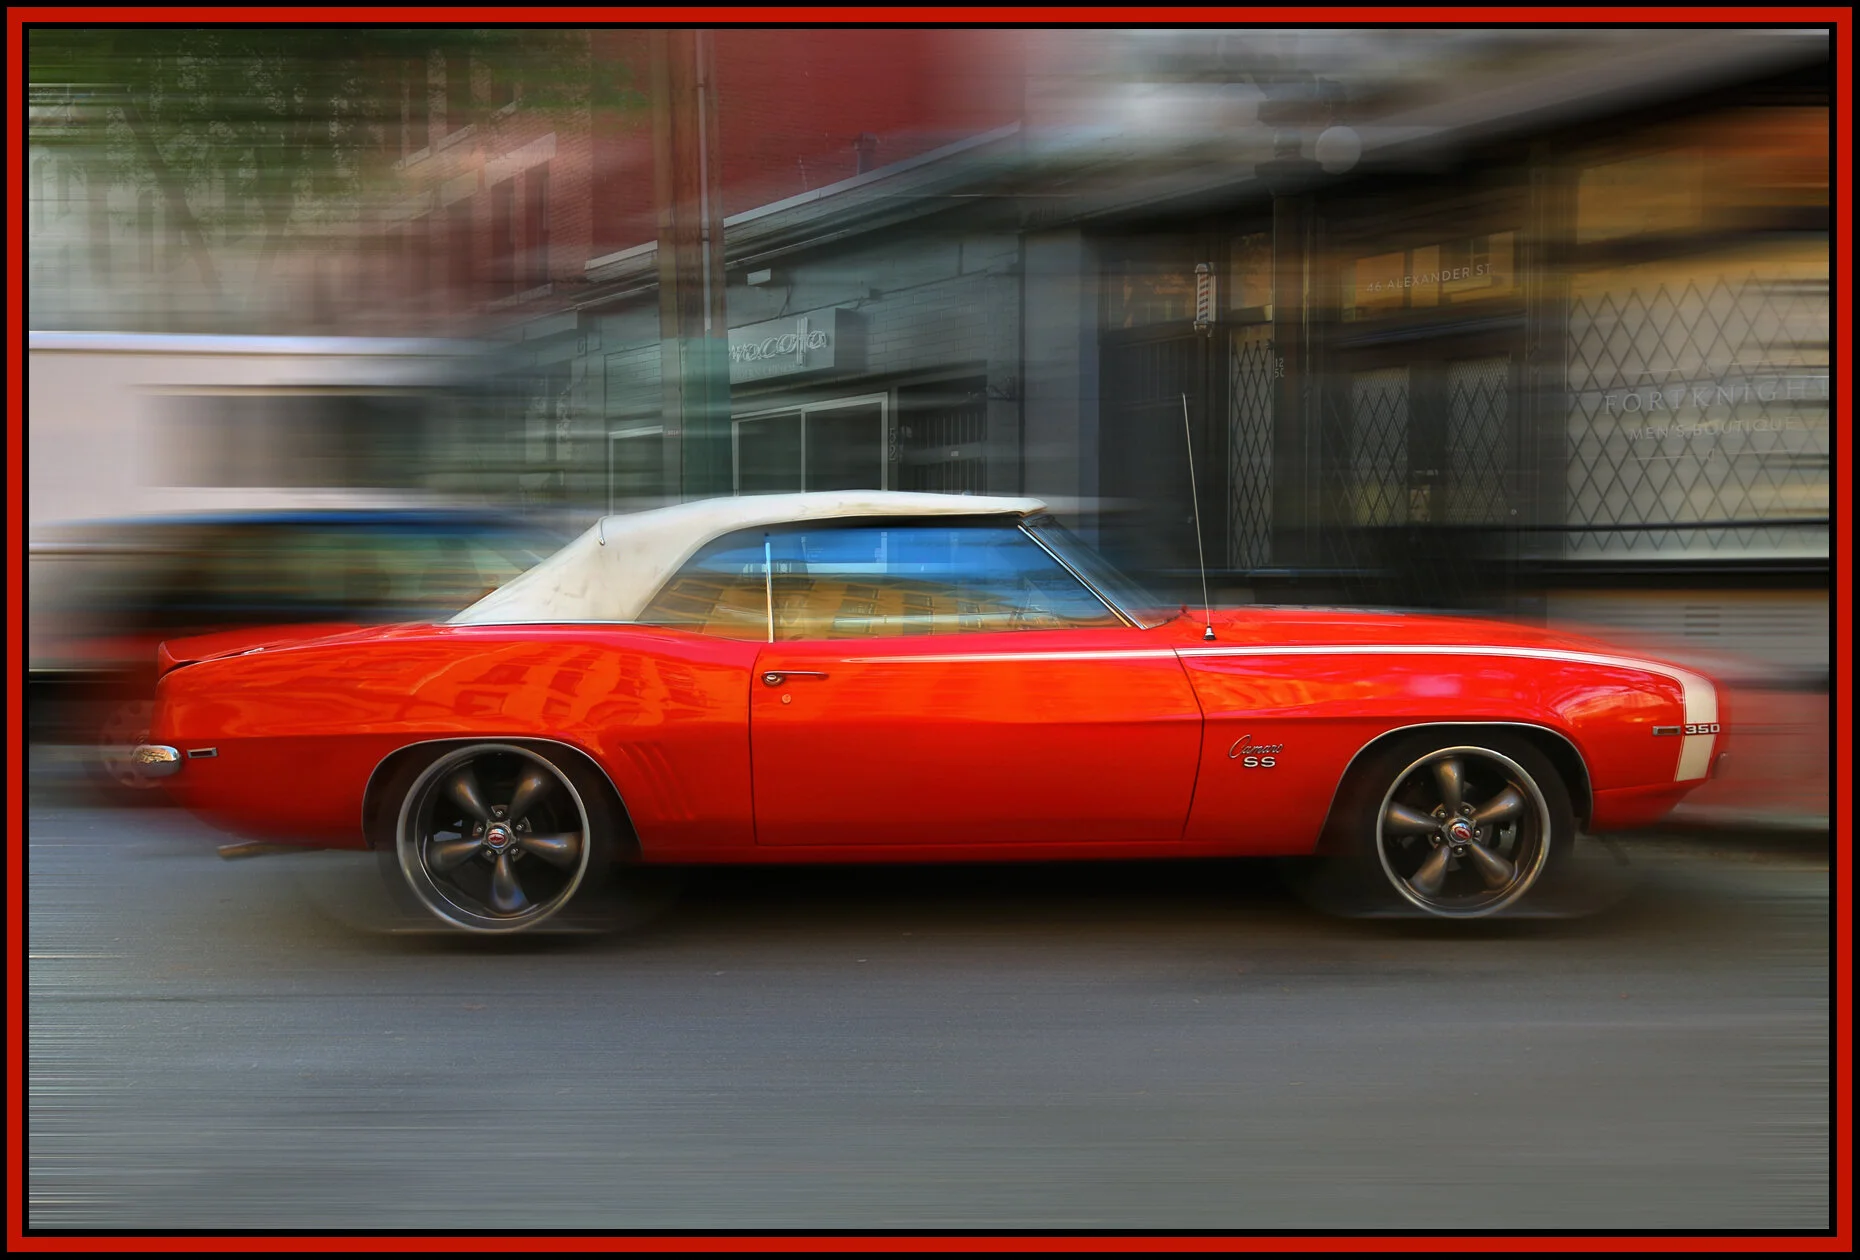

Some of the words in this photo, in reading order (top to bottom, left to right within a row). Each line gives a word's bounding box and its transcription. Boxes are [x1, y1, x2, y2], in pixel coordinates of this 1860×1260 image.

[1367, 281, 1382, 293] 46
[1387, 267, 1470, 289] ALEXANDER
[1630, 424, 1685, 440] MEN'S
[1693, 416, 1796, 436] BOUTIQUE
[1685, 724, 1720, 735] 350
[1229, 734, 1284, 758] Camaro
[1243, 756, 1276, 768] SS
